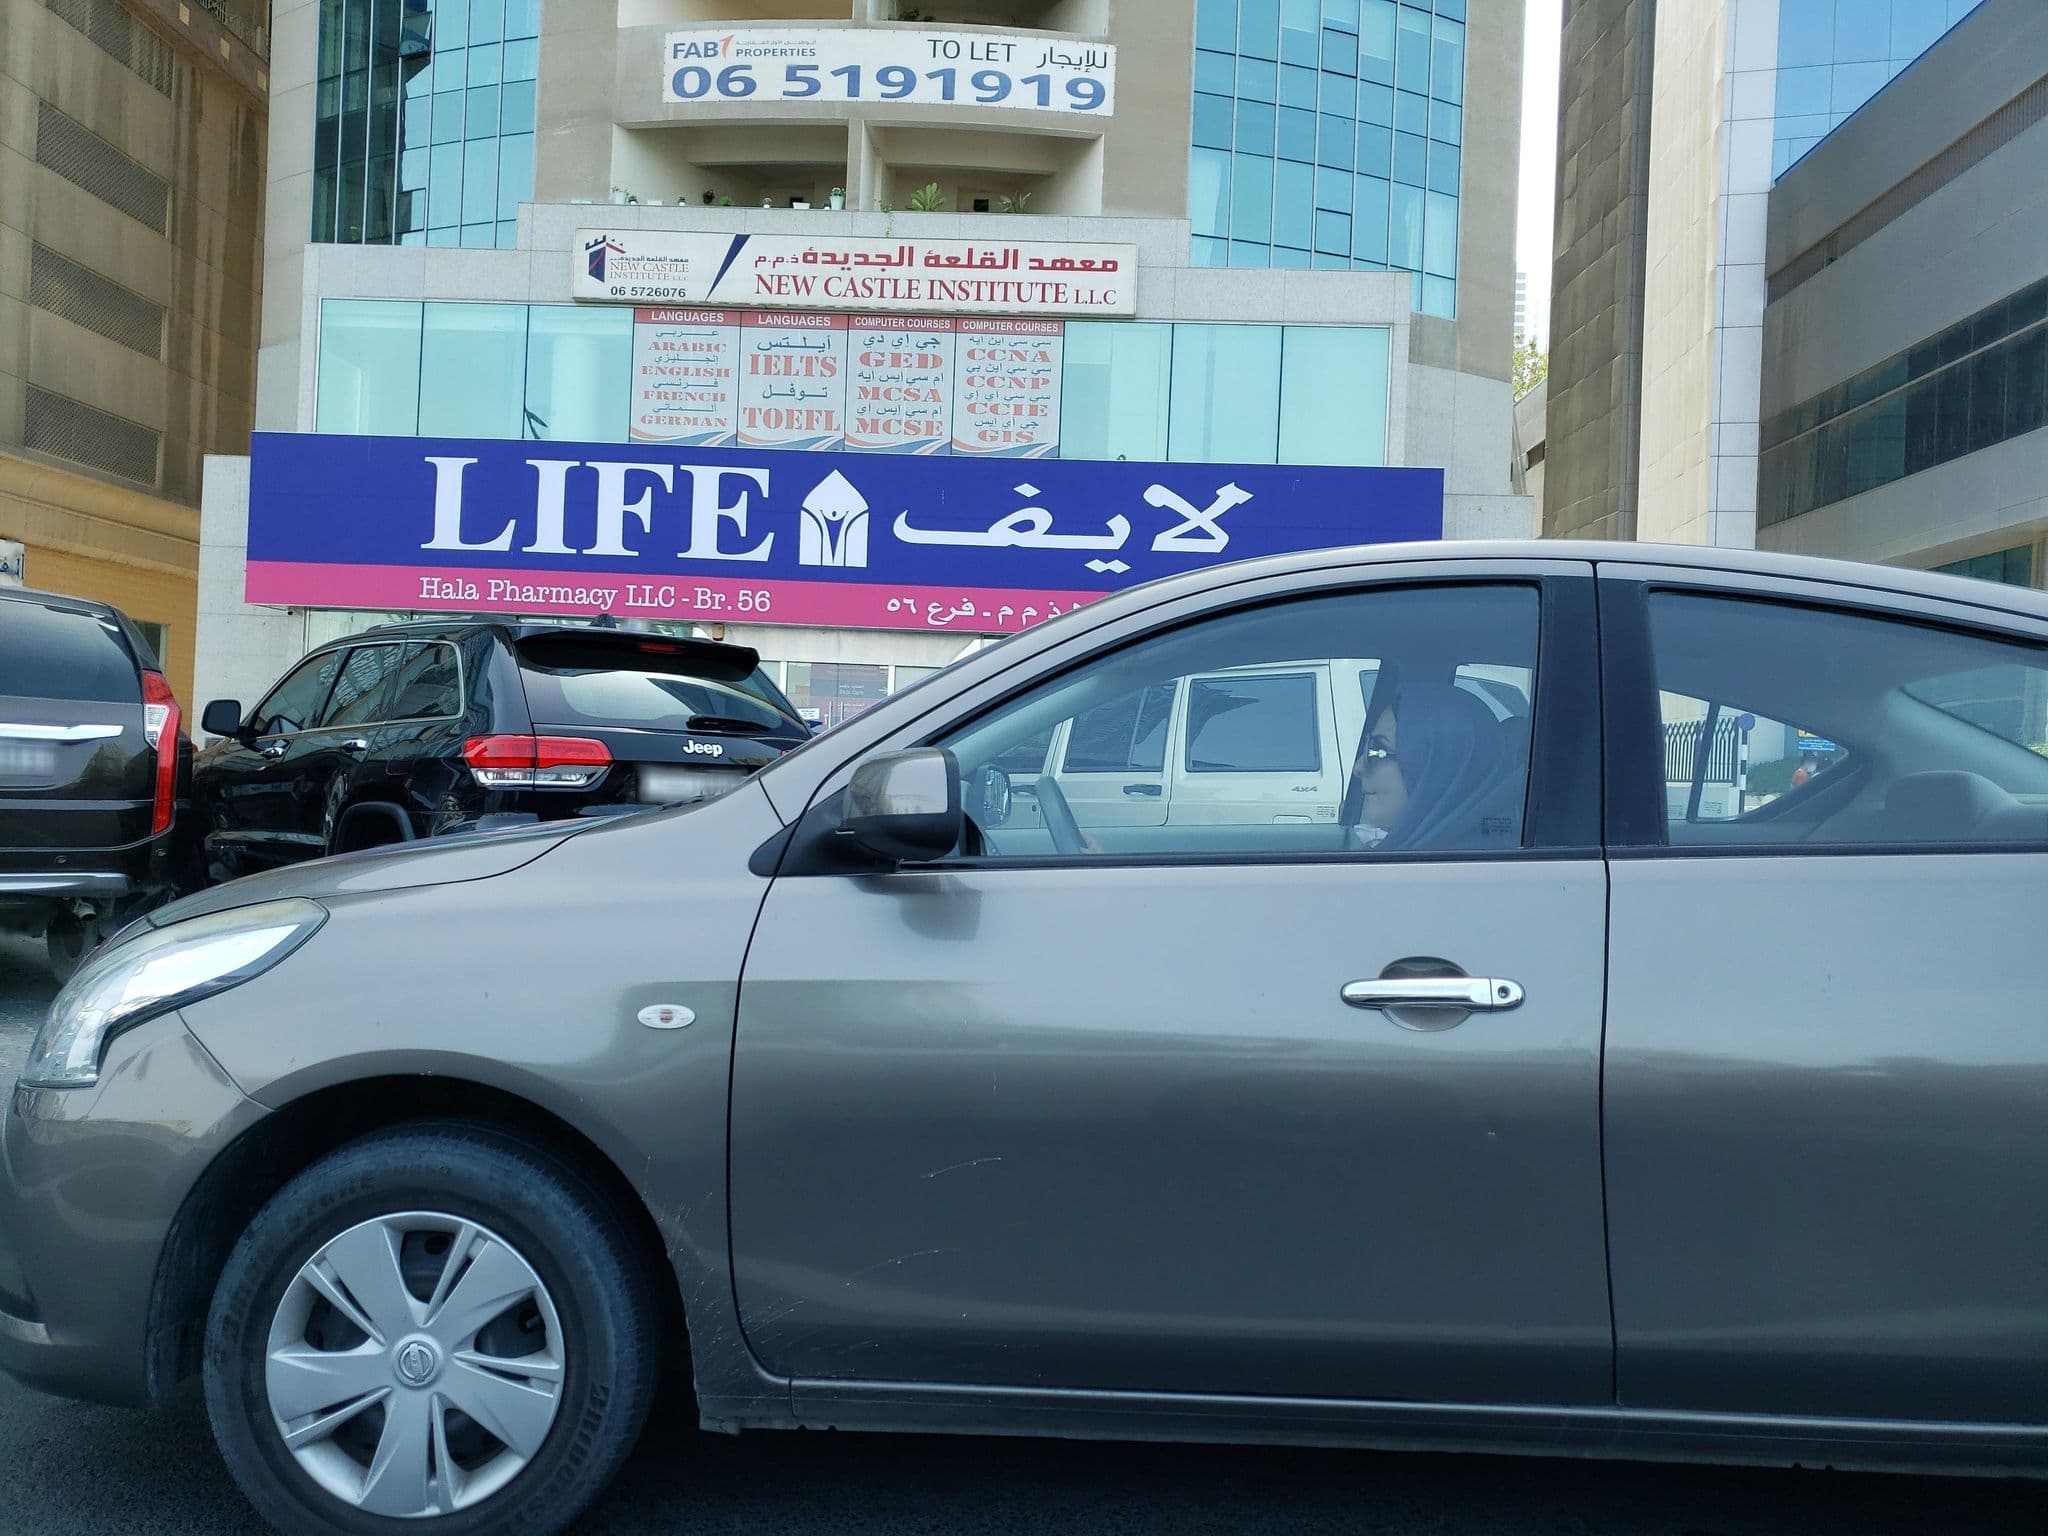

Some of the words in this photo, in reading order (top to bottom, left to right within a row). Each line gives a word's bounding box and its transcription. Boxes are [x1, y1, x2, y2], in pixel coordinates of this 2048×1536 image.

[672, 42, 720, 59] FAB
[736, 48, 817, 57] PROPERTIES
[927, 38, 960, 59] TO
[970, 41, 1017, 62] LET
[1036, 46, 1107, 73] للإيجار
[672, 64, 758, 99] 06
[782, 65, 1107, 110] 5191919
[610, 261, 641, 271] NEW
[643, 262, 690, 273] CASTLE
[924, 247, 1019, 271] القلعة
[1028, 256, 1119, 273] معهد
[610, 271, 670, 281] INSTITUTE
[610, 286, 626, 296] 06
[630, 286, 687, 298] 5726076
[754, 273, 818, 297] NEW
[823, 275, 920, 301] CASTLE
[926, 278, 1069, 306] INSTITUTE
[651, 311, 725, 323] LANGUAGES
[757, 314, 831, 327] LANGUAGES
[855, 317, 905, 328] COMPUTER
[907, 318, 951, 330] COURSES
[962, 320, 1013, 331] COMPUTER
[1015, 322, 1060, 333] COURSES
[647, 342, 728, 353] ARABIC
[966, 348, 1051, 363] CCNA
[749, 353, 838, 378] IELTS
[858, 351, 944, 369] GED
[640, 365, 731, 378] ENGLISH
[965, 375, 1051, 390] CCNP
[642, 390, 727, 402] FRENCH
[857, 386, 944, 403] MCSA
[965, 402, 1049, 417] CCIE
[639, 415, 728, 427] GERMAN
[742, 407, 841, 432] TOEFL
[855, 417, 944, 437] MCSE
[976, 429, 1035, 443] GIS
[420, 456, 775, 562] LIFE
[893, 480, 1254, 573] لايف
[419, 577, 480, 601] Hala
[487, 579, 618, 610] Pharmacy
[625, 585, 676, 609] LLC
[927, 597, 976, 626] فرع
[682, 739, 724, 758] Jeep
